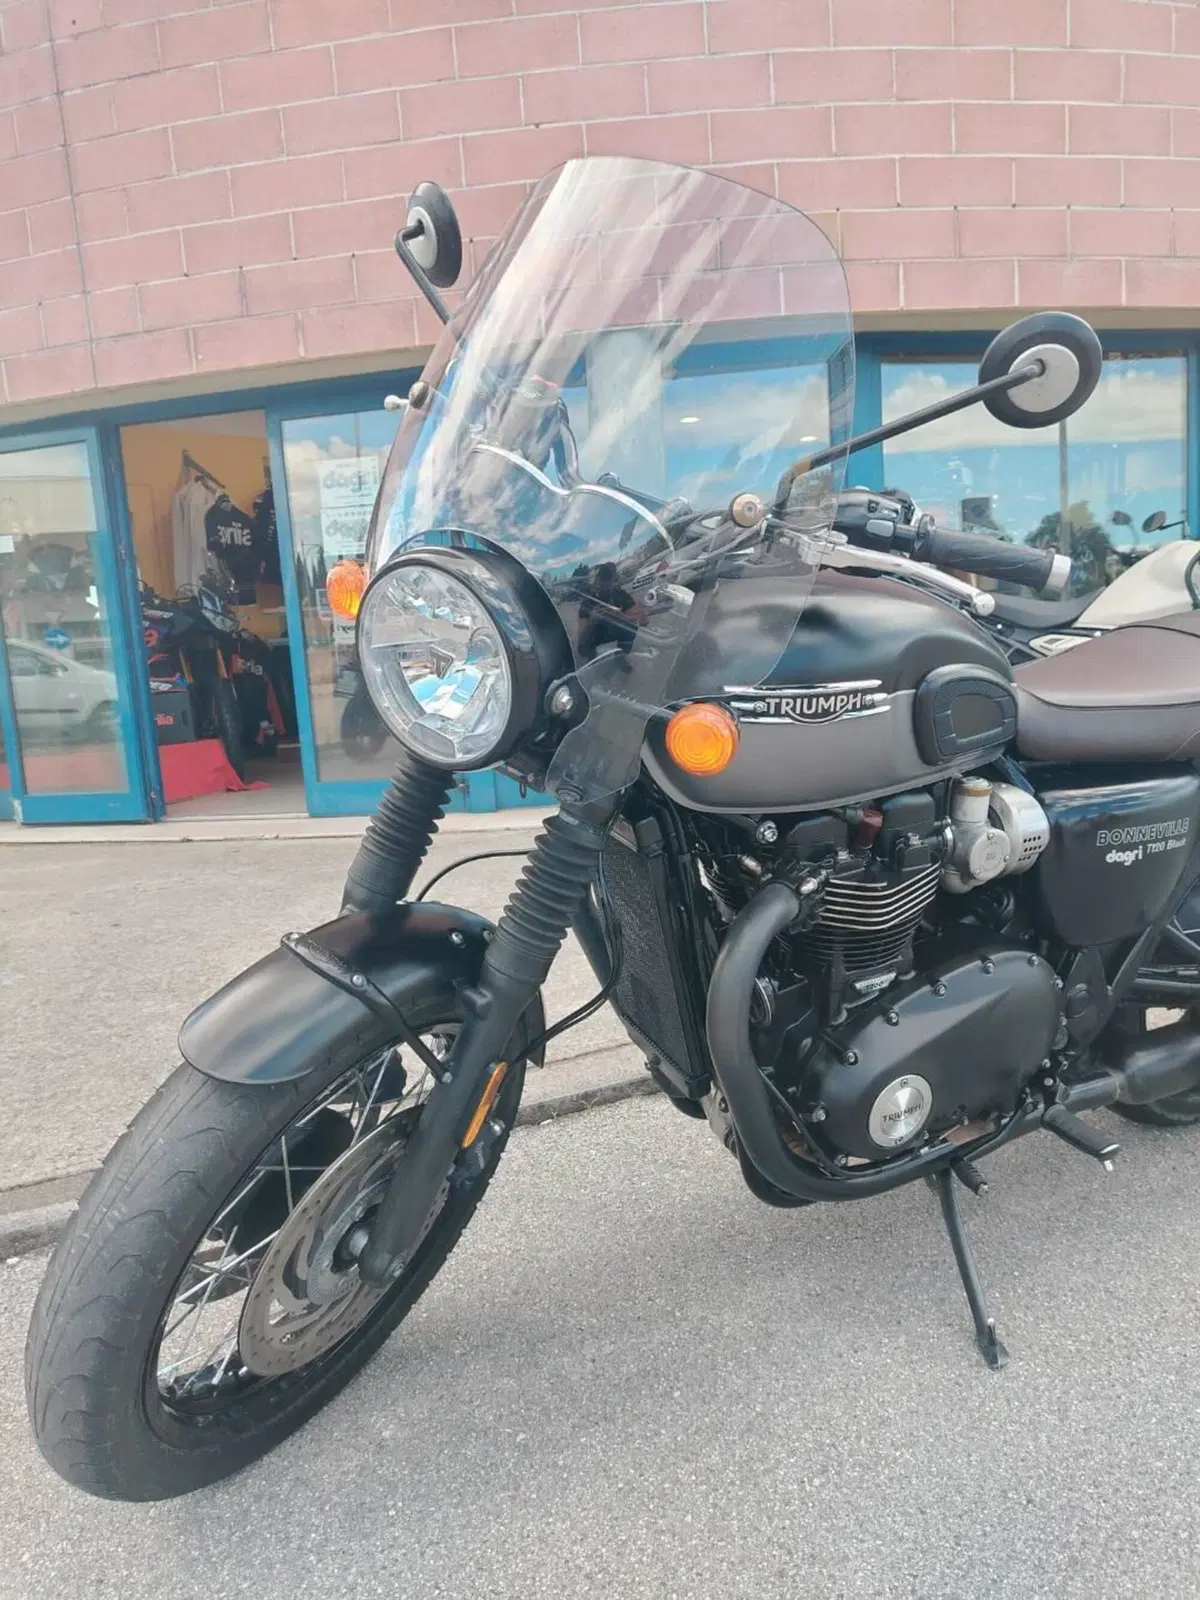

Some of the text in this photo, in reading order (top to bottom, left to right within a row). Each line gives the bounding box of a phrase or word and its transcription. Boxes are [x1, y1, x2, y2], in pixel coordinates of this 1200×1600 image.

[765, 693, 863, 719] TRIUMPH
[1096, 817, 1190, 846] BONNEVILLE
[1105, 845, 1143, 866] dagri
[1146, 841, 1165, 854] T120
[881, 1103, 922, 1123] TRIUMPH
